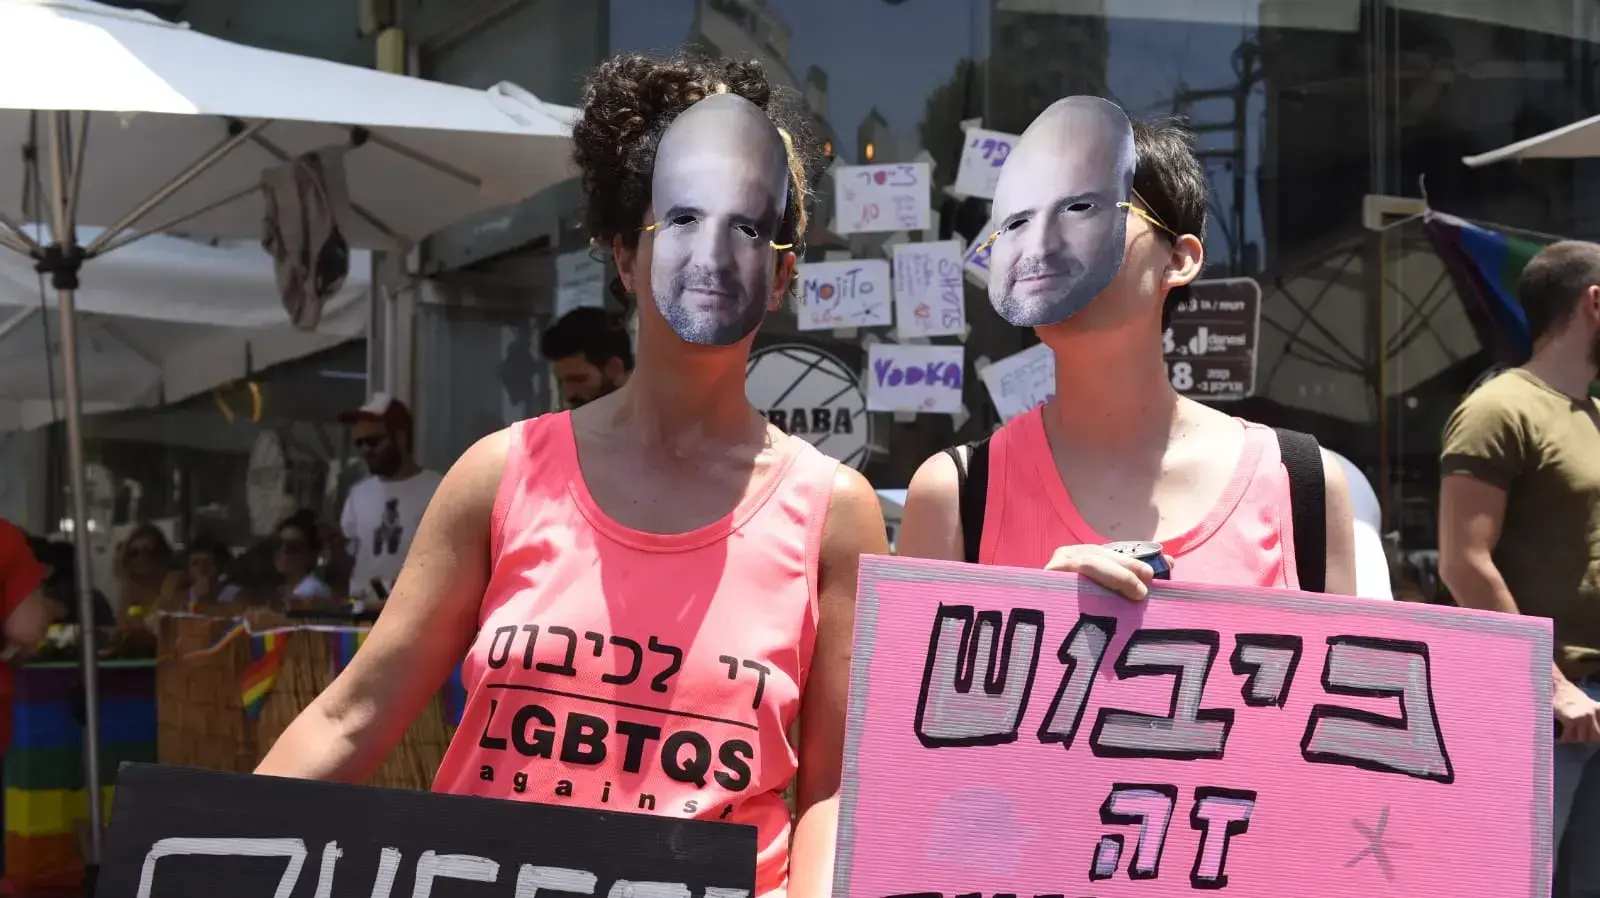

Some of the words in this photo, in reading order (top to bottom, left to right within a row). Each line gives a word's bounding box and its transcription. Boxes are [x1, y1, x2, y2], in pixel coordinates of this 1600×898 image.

[719, 655, 771, 710] די
[914, 602, 1455, 783] כיבוש
[479, 699, 755, 793] LGBTQS
[480, 762, 734, 819] against
[1088, 783, 1258, 888] זה
